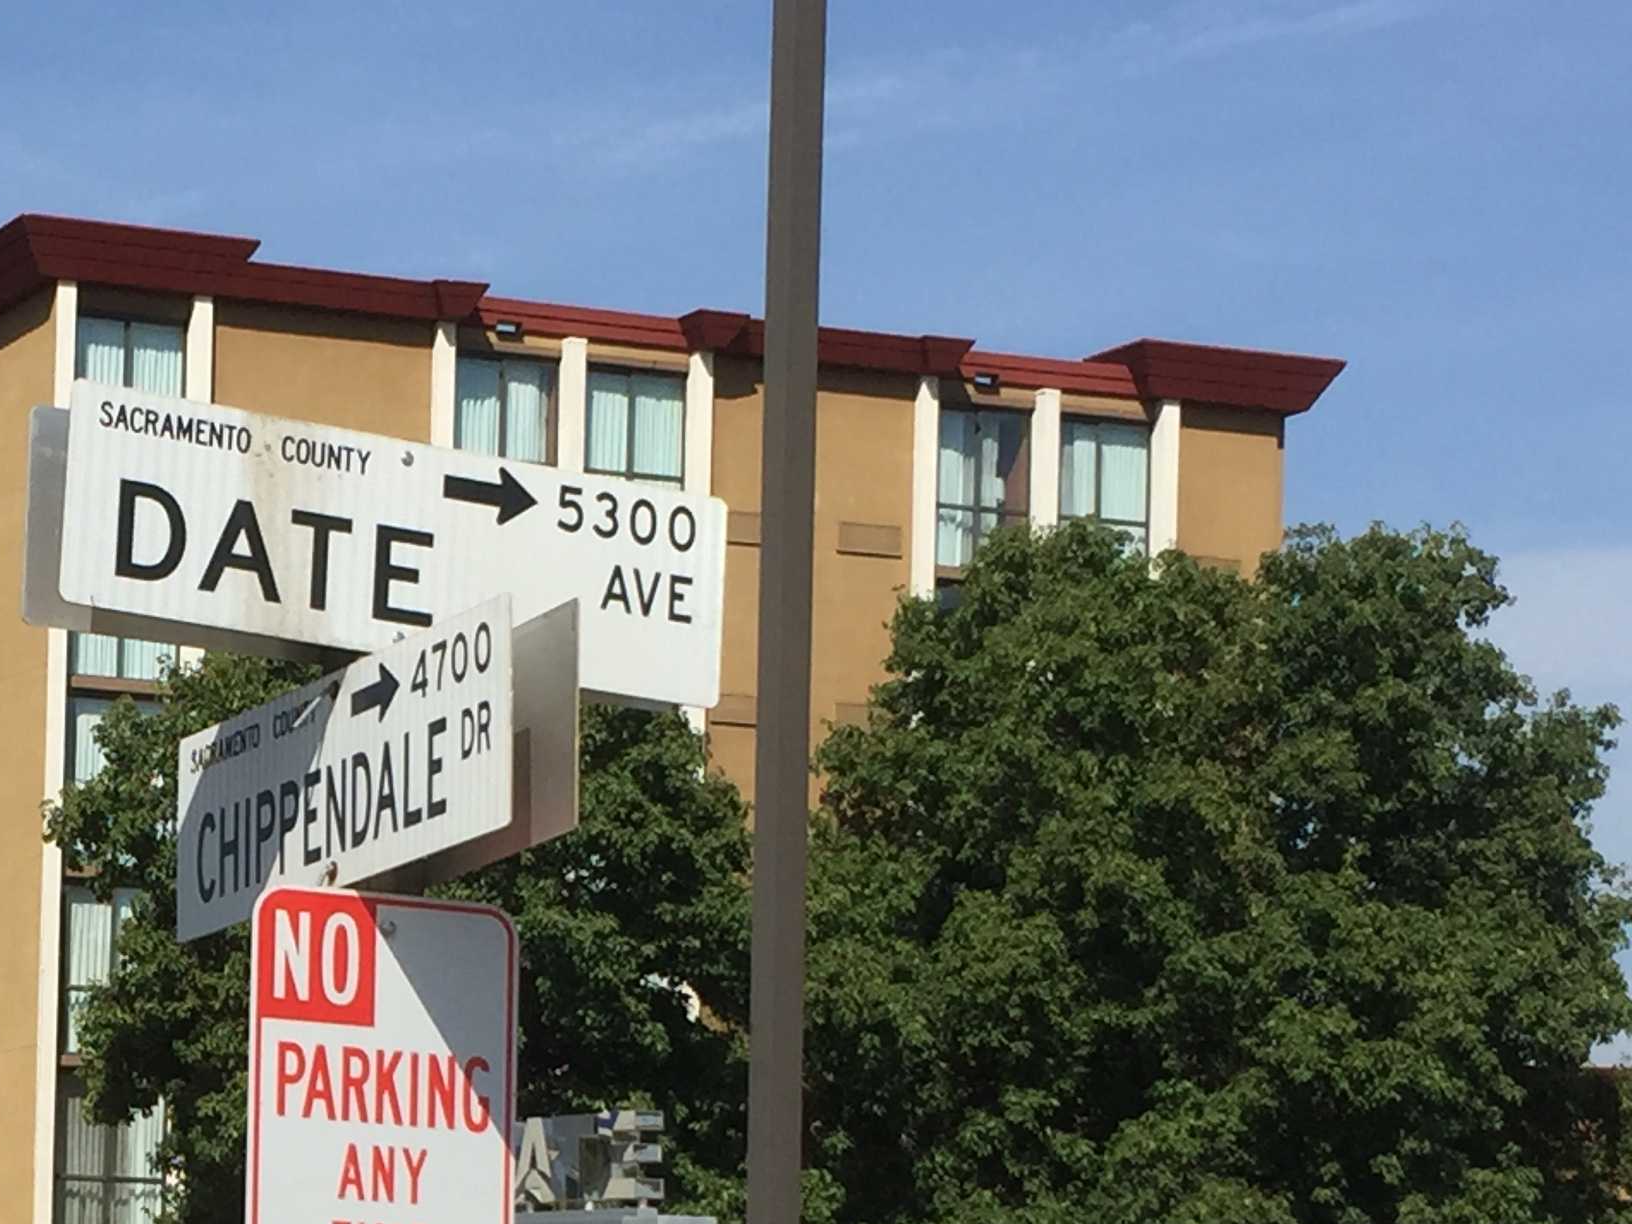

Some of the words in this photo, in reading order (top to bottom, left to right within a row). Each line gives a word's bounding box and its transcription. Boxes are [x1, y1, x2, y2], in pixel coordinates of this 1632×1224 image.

[99, 401, 252, 455] SACRAMENTO
[280, 438, 372, 476] COUNTY
[114, 477, 435, 627] DATE
[600, 563, 695, 625] AVE
[556, 485, 698, 553] 5300
[410, 621, 492, 698] 4700
[197, 716, 447, 903] CHIPPENDALE
[461, 700, 491, 760] DR
[272, 908, 360, 1005] NO
[275, 1041, 491, 1133] PARKING
[337, 1144, 428, 1205] ANY
